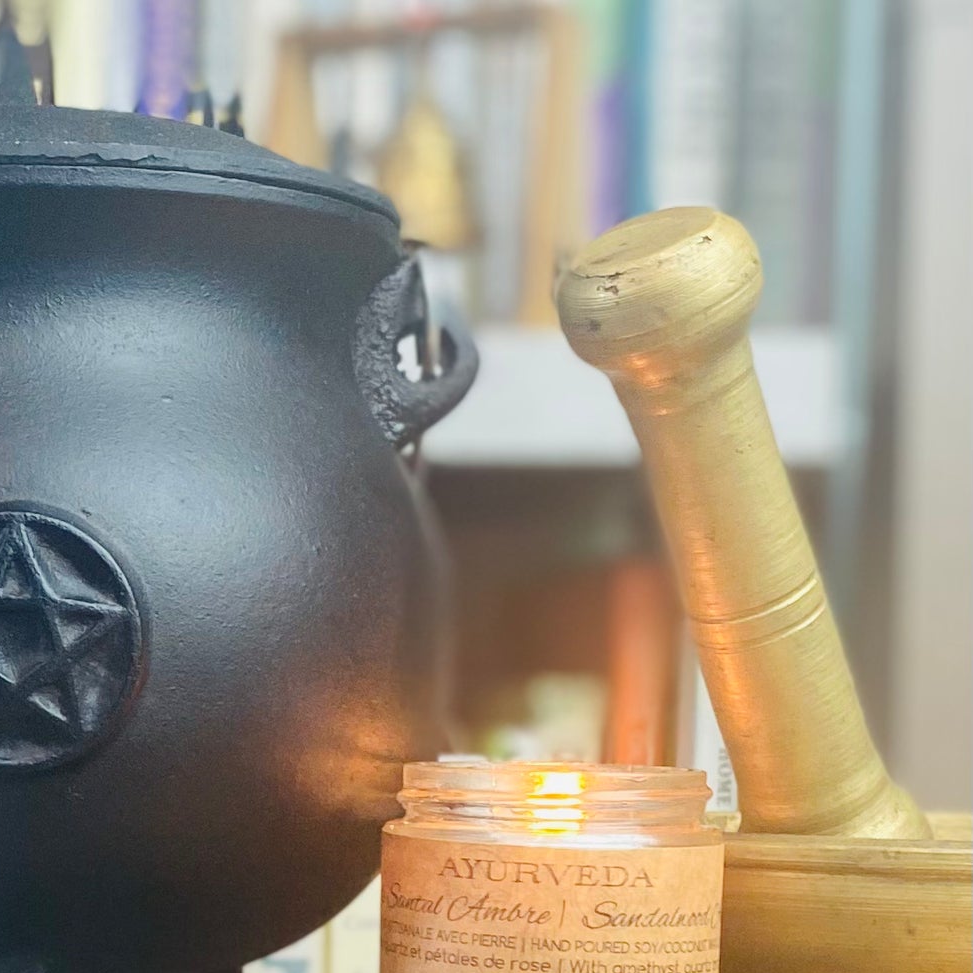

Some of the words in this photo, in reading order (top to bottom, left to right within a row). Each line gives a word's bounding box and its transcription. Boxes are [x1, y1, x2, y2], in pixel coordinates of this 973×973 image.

[437, 856, 654, 888] AYURVEDA
[387, 882, 444, 915] Santal
[446, 893, 553, 925] Ambre
[435, 930, 469, 945] AVEC
[471, 934, 517, 949] PIERRE
[531, 938, 572, 952] HAND
[574, 940, 631, 954] POURED
[410, 946, 422, 959] et
[424, 947, 479, 967] pétales
[483, 954, 506, 970] de
[510, 958, 552, 973] rose
